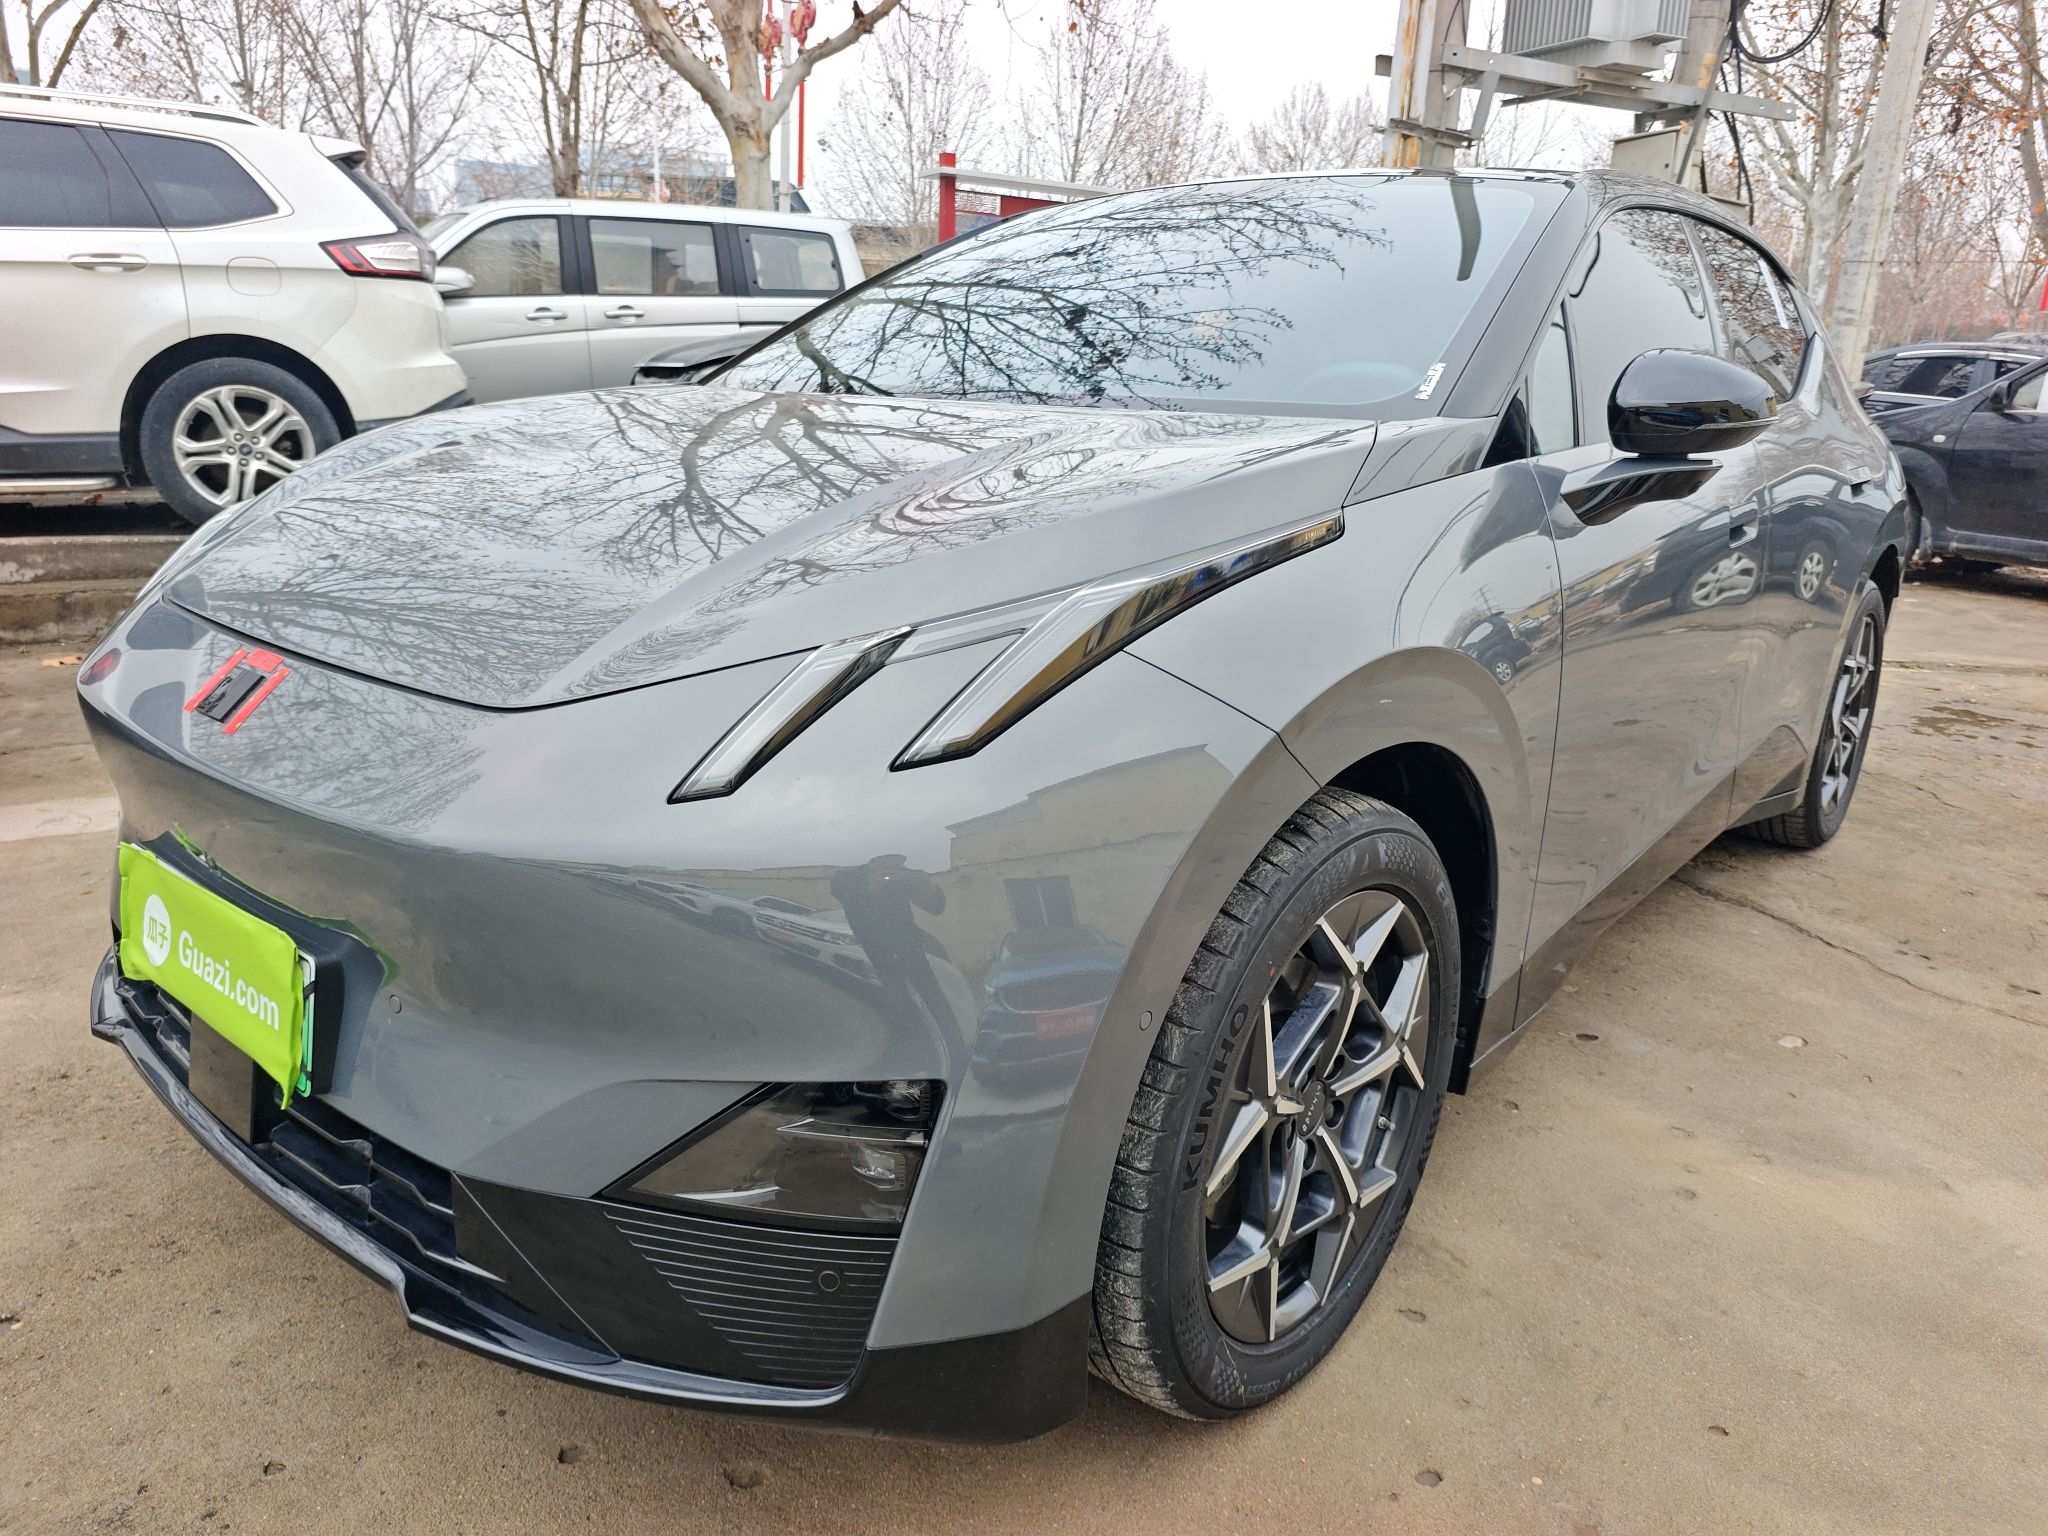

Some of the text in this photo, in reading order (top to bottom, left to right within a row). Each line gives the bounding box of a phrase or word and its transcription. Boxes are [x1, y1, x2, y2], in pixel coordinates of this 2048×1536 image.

[149, 916, 168, 949] 瓜子
[179, 930, 279, 1031] Guazi.com
[1182, 1003, 1249, 1191] KUMHO
